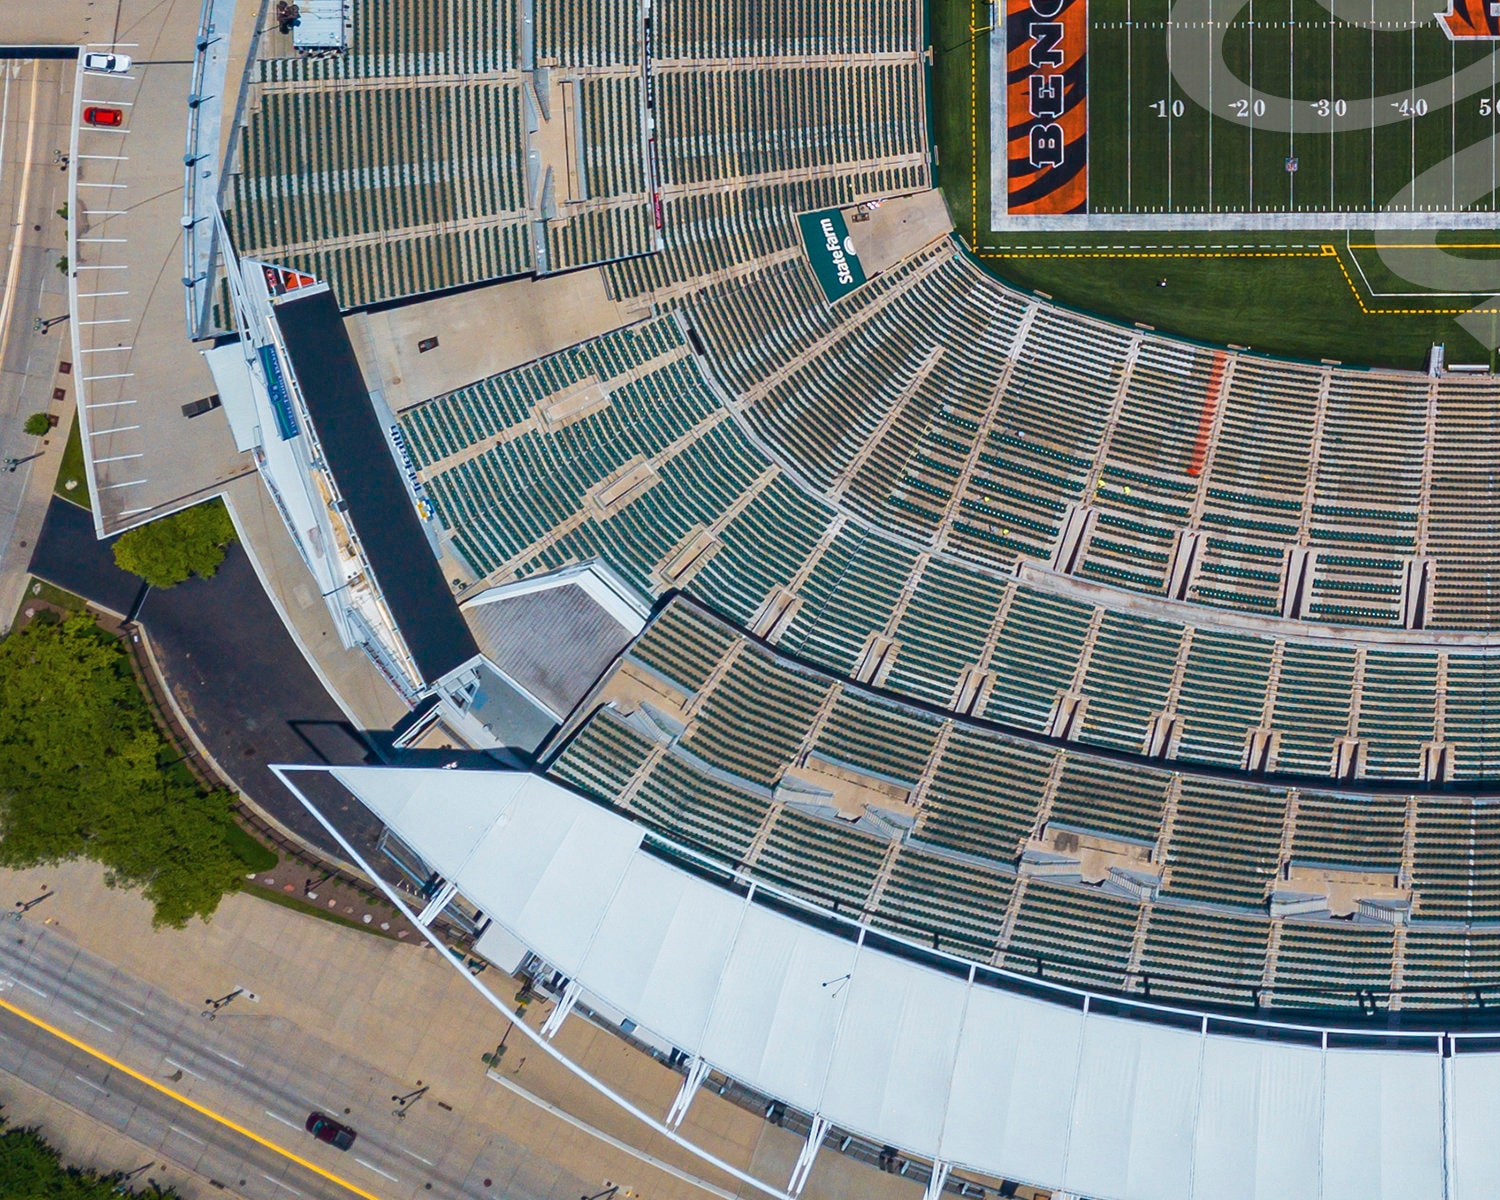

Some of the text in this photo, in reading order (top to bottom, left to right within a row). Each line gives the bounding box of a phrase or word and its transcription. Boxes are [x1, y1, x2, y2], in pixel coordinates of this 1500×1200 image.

[1158, 98, 1185, 118] 10
[1234, 98, 1266, 118] 20
[1317, 98, 1348, 118] 30
[1398, 98, 1429, 118] 40
